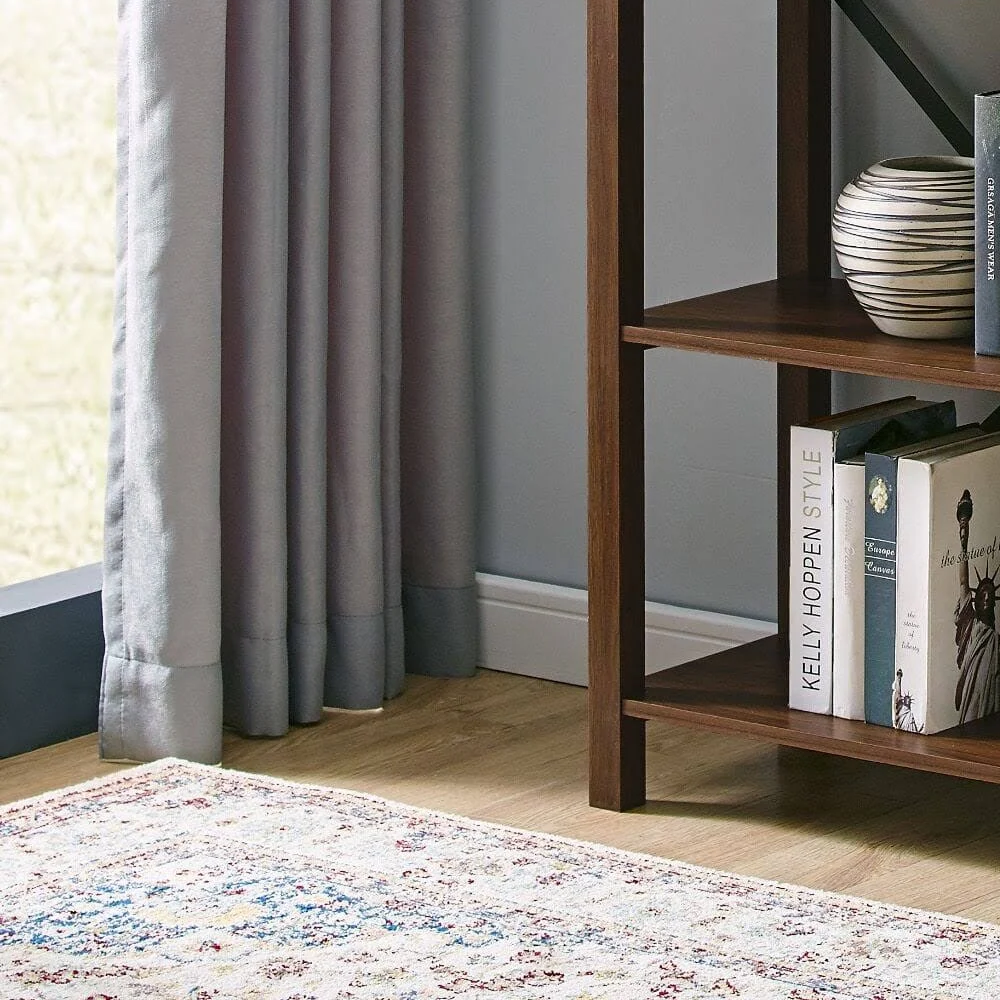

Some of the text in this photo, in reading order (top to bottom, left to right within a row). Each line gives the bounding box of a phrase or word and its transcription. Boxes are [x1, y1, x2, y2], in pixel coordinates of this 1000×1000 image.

[986, 220, 994, 250] MEN'S
[986, 250, 994, 281] WEAR
[865, 541, 896, 558] Europe
[940, 549, 956, 568] the
[986, 536, 997, 559] of
[802, 447, 821, 691] KELLY HOPPEN STYLE
[865, 561, 896, 575] Canvas
